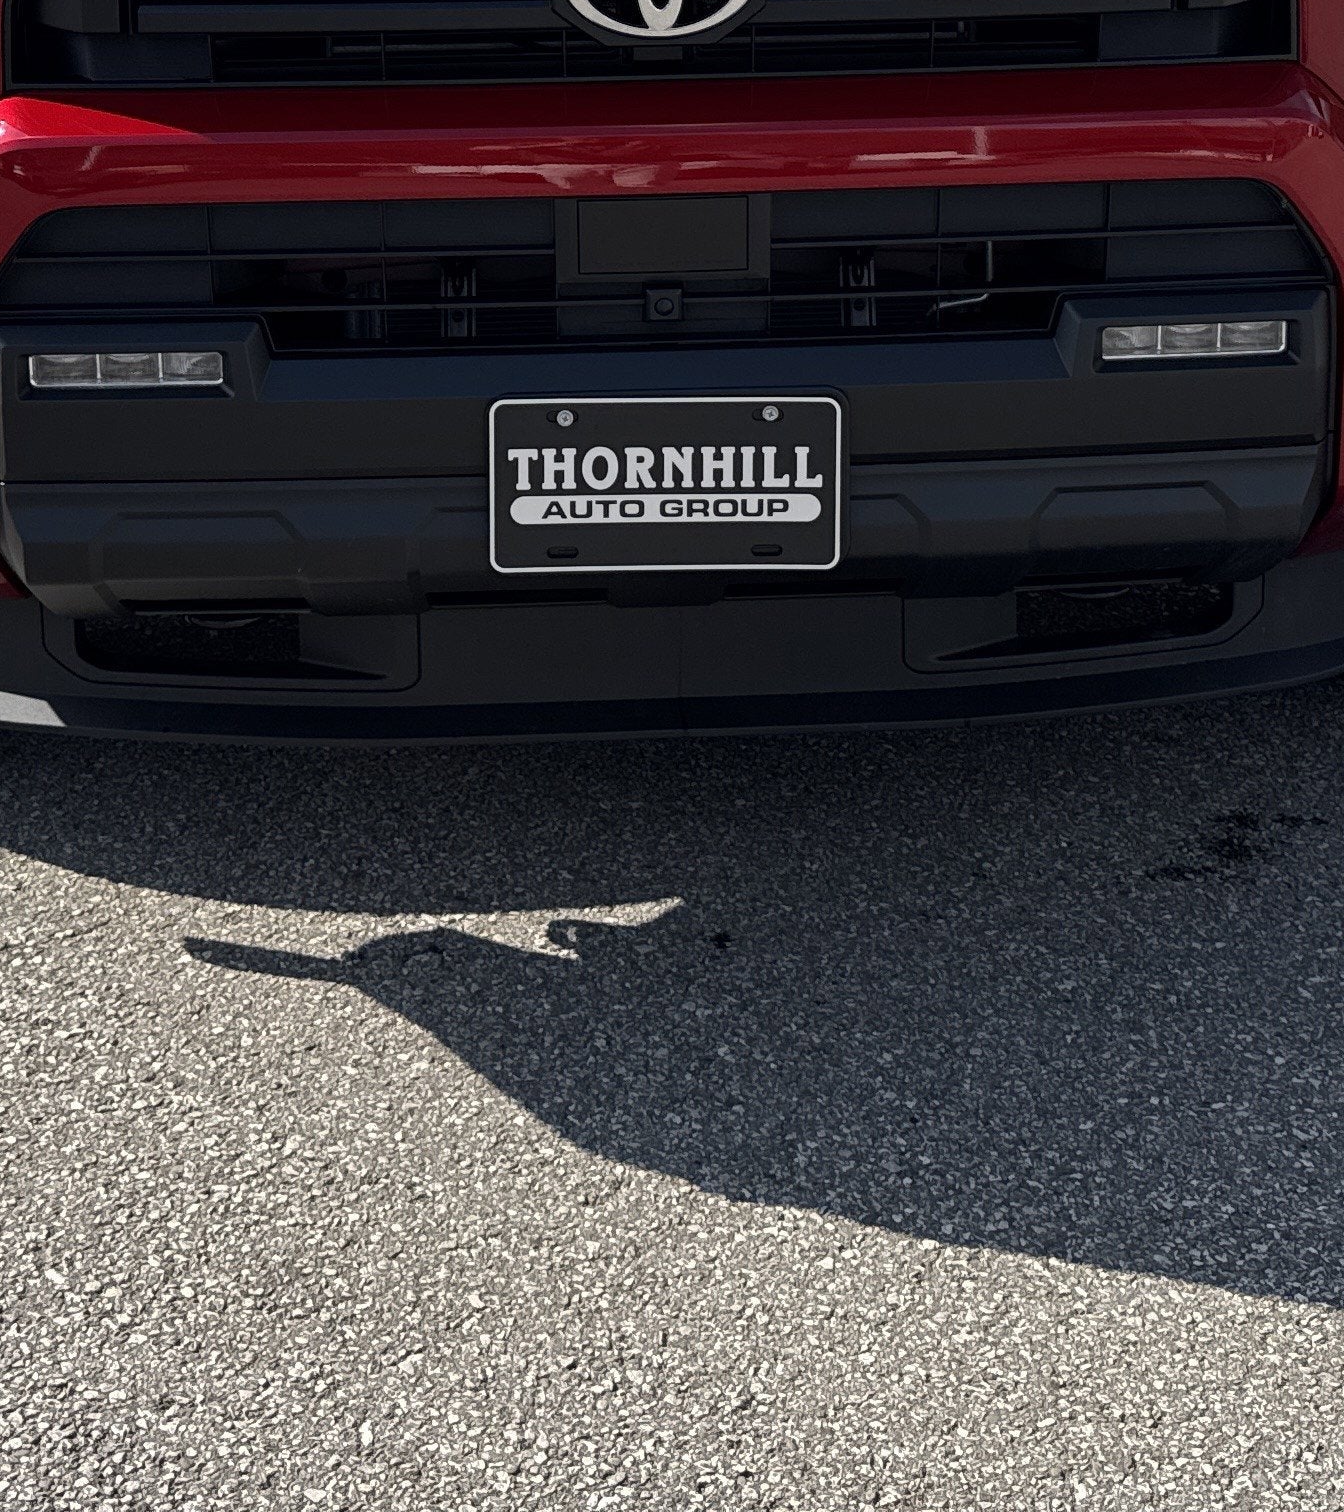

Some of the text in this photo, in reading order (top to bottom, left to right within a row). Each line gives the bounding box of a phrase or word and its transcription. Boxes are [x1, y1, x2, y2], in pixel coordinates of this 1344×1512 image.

[507, 445, 824, 491] THORNHILL
[541, 497, 790, 520] AUTO GROUP
